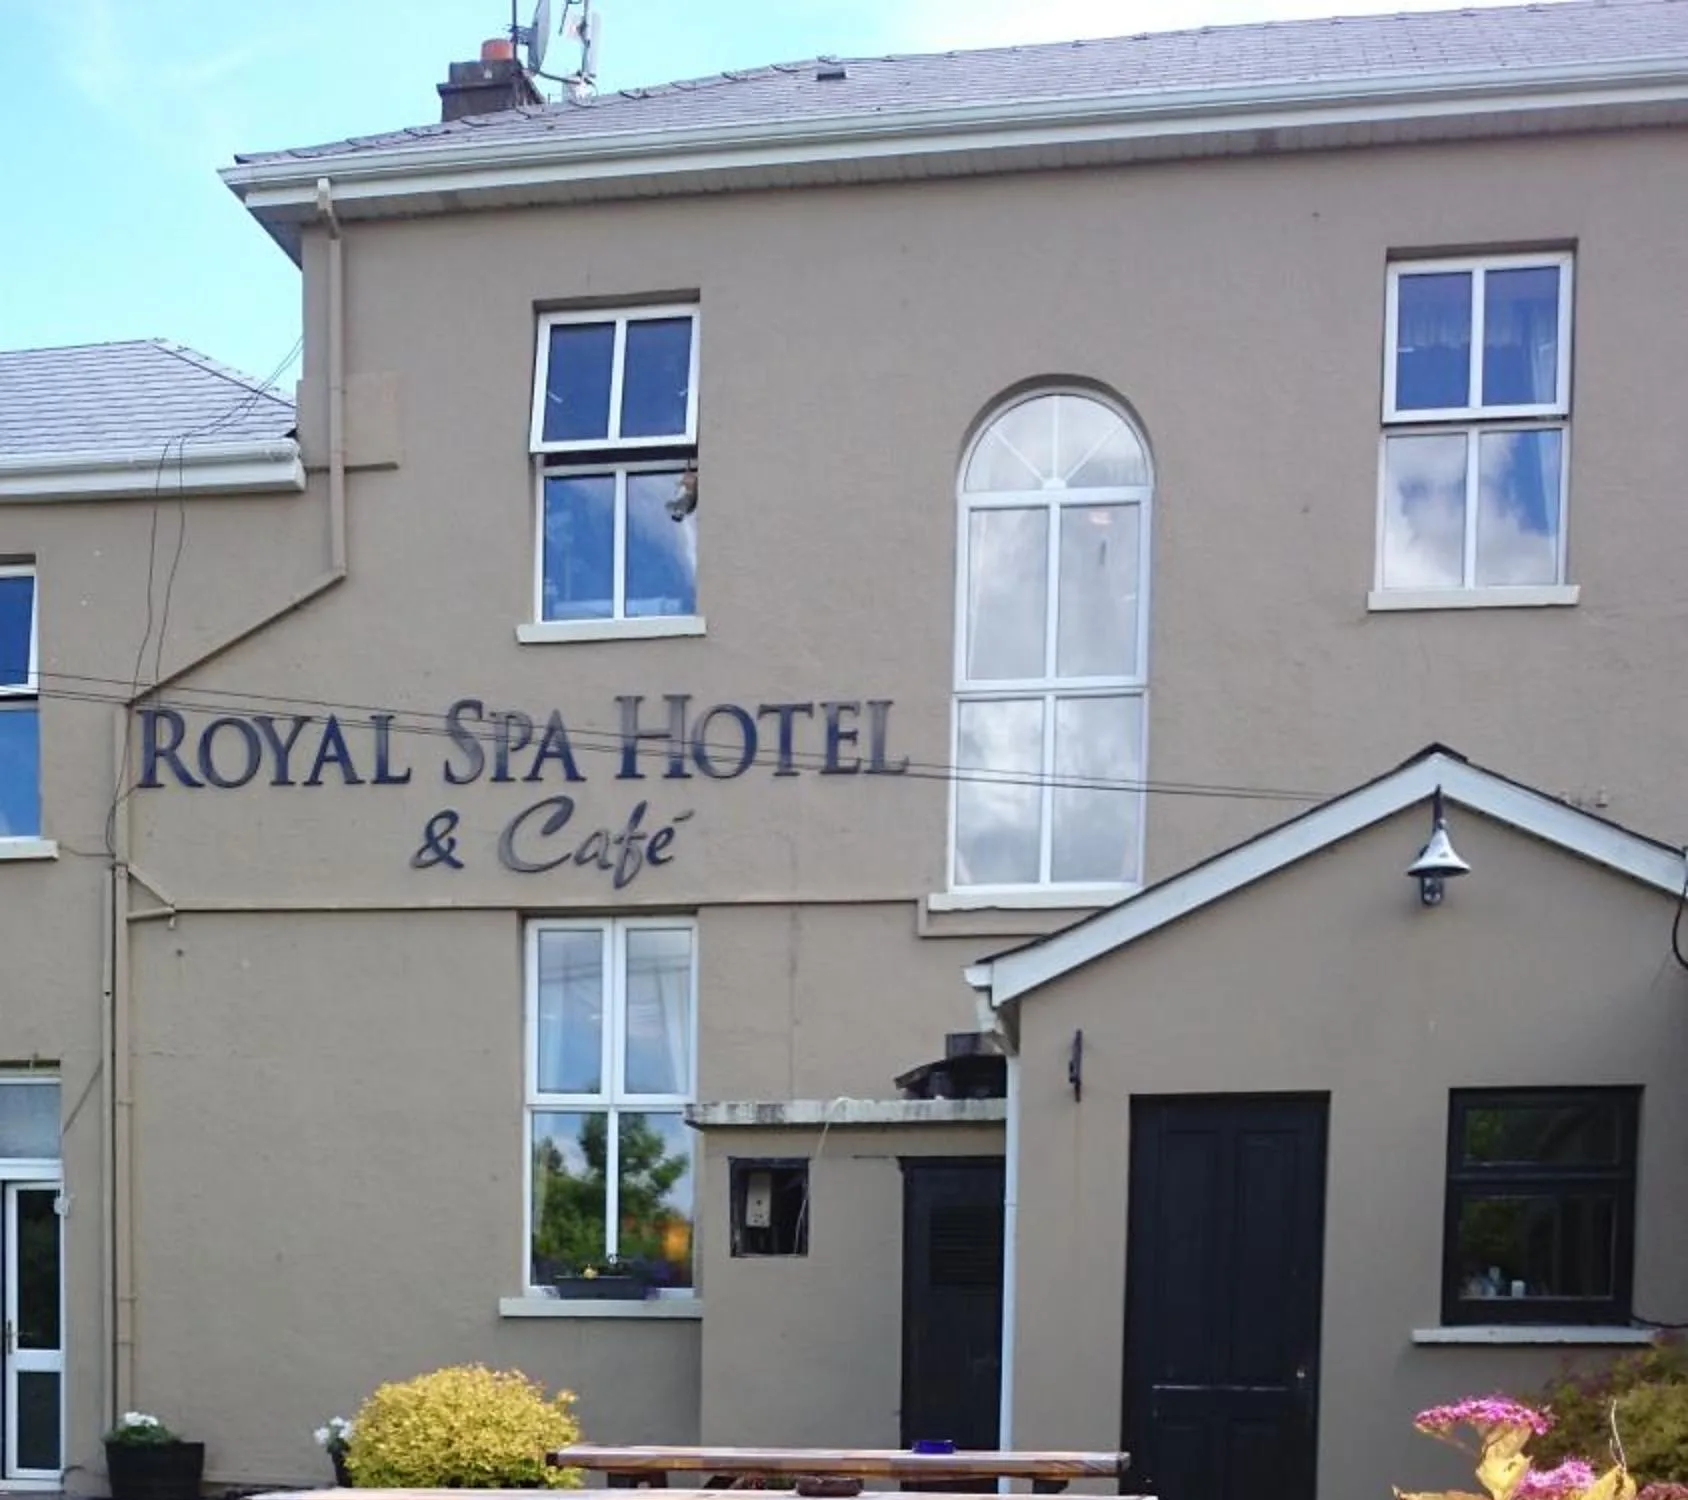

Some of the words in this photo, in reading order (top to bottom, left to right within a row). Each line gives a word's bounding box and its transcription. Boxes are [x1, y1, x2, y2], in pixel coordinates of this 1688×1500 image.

[138, 707, 412, 790] ROYAL
[443, 699, 587, 783] SPA
[614, 693, 910, 780] HOTEL
[412, 810, 466, 870] &
[497, 796, 696, 889] Café
